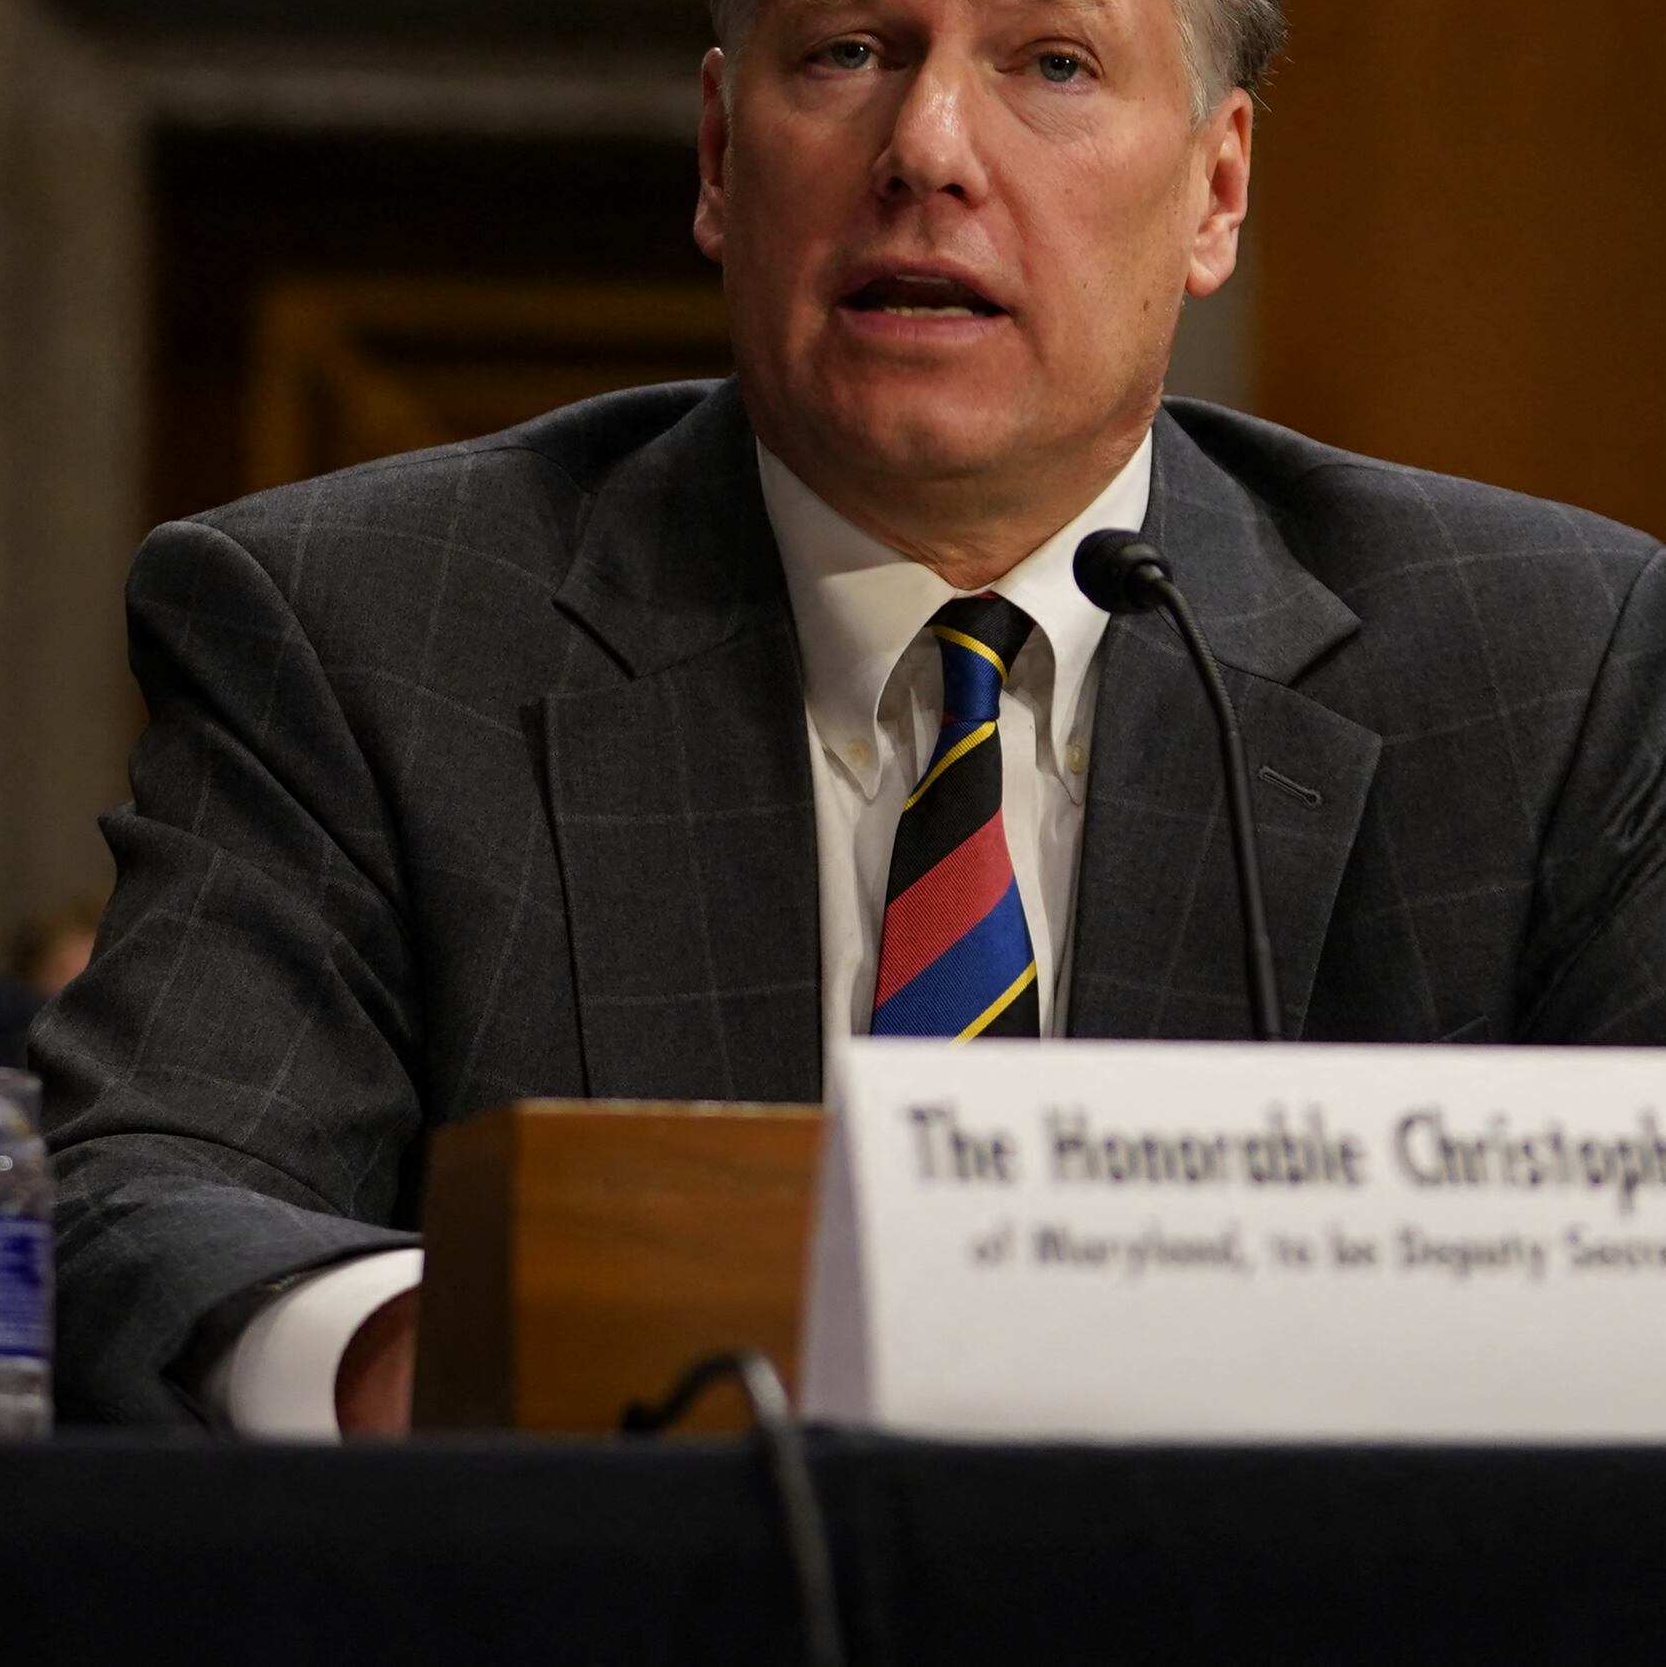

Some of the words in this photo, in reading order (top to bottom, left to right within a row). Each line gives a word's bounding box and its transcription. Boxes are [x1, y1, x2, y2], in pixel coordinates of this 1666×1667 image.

[903, 1103, 1016, 1185] The
[1044, 1102, 1366, 1186] Honorable
[971, 1220, 1014, 1266] of
[1274, 1226, 1313, 1267] to
[1328, 1222, 1377, 1268] be
